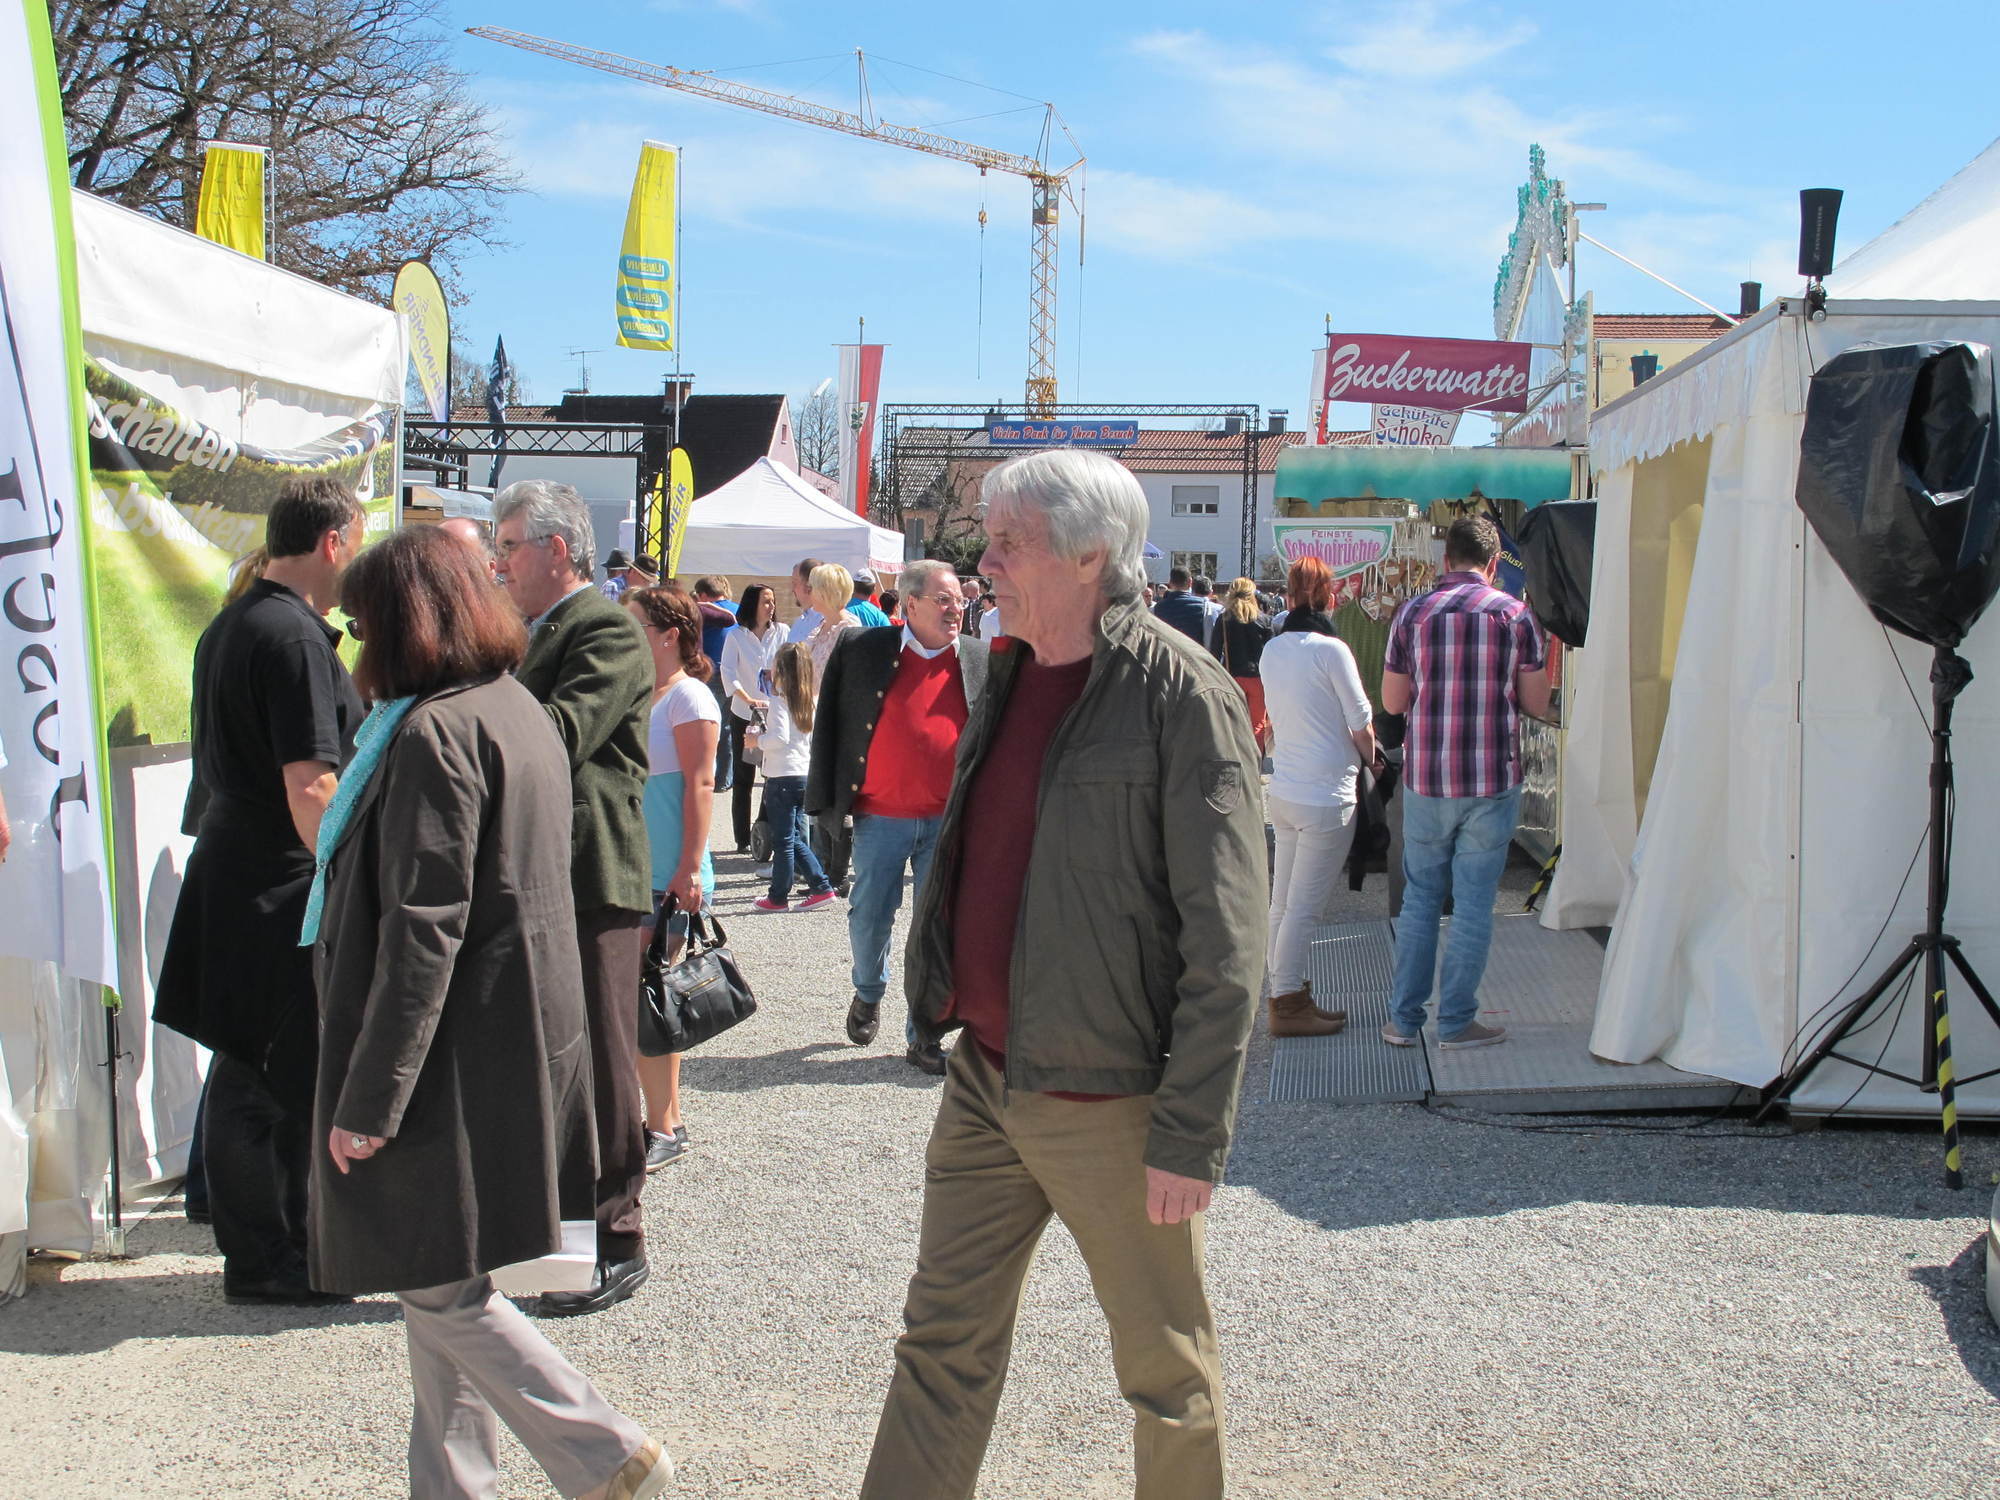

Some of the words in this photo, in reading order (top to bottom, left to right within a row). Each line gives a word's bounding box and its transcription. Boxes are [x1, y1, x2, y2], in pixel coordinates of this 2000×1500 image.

[1328, 343, 1527, 399] Zuckerwatte
[992, 425, 1020, 440] Vielen
[1023, 425, 1049, 440] Dank
[1100, 424, 1135, 440] Besuch
[1311, 529, 1353, 539] FEINSTE
